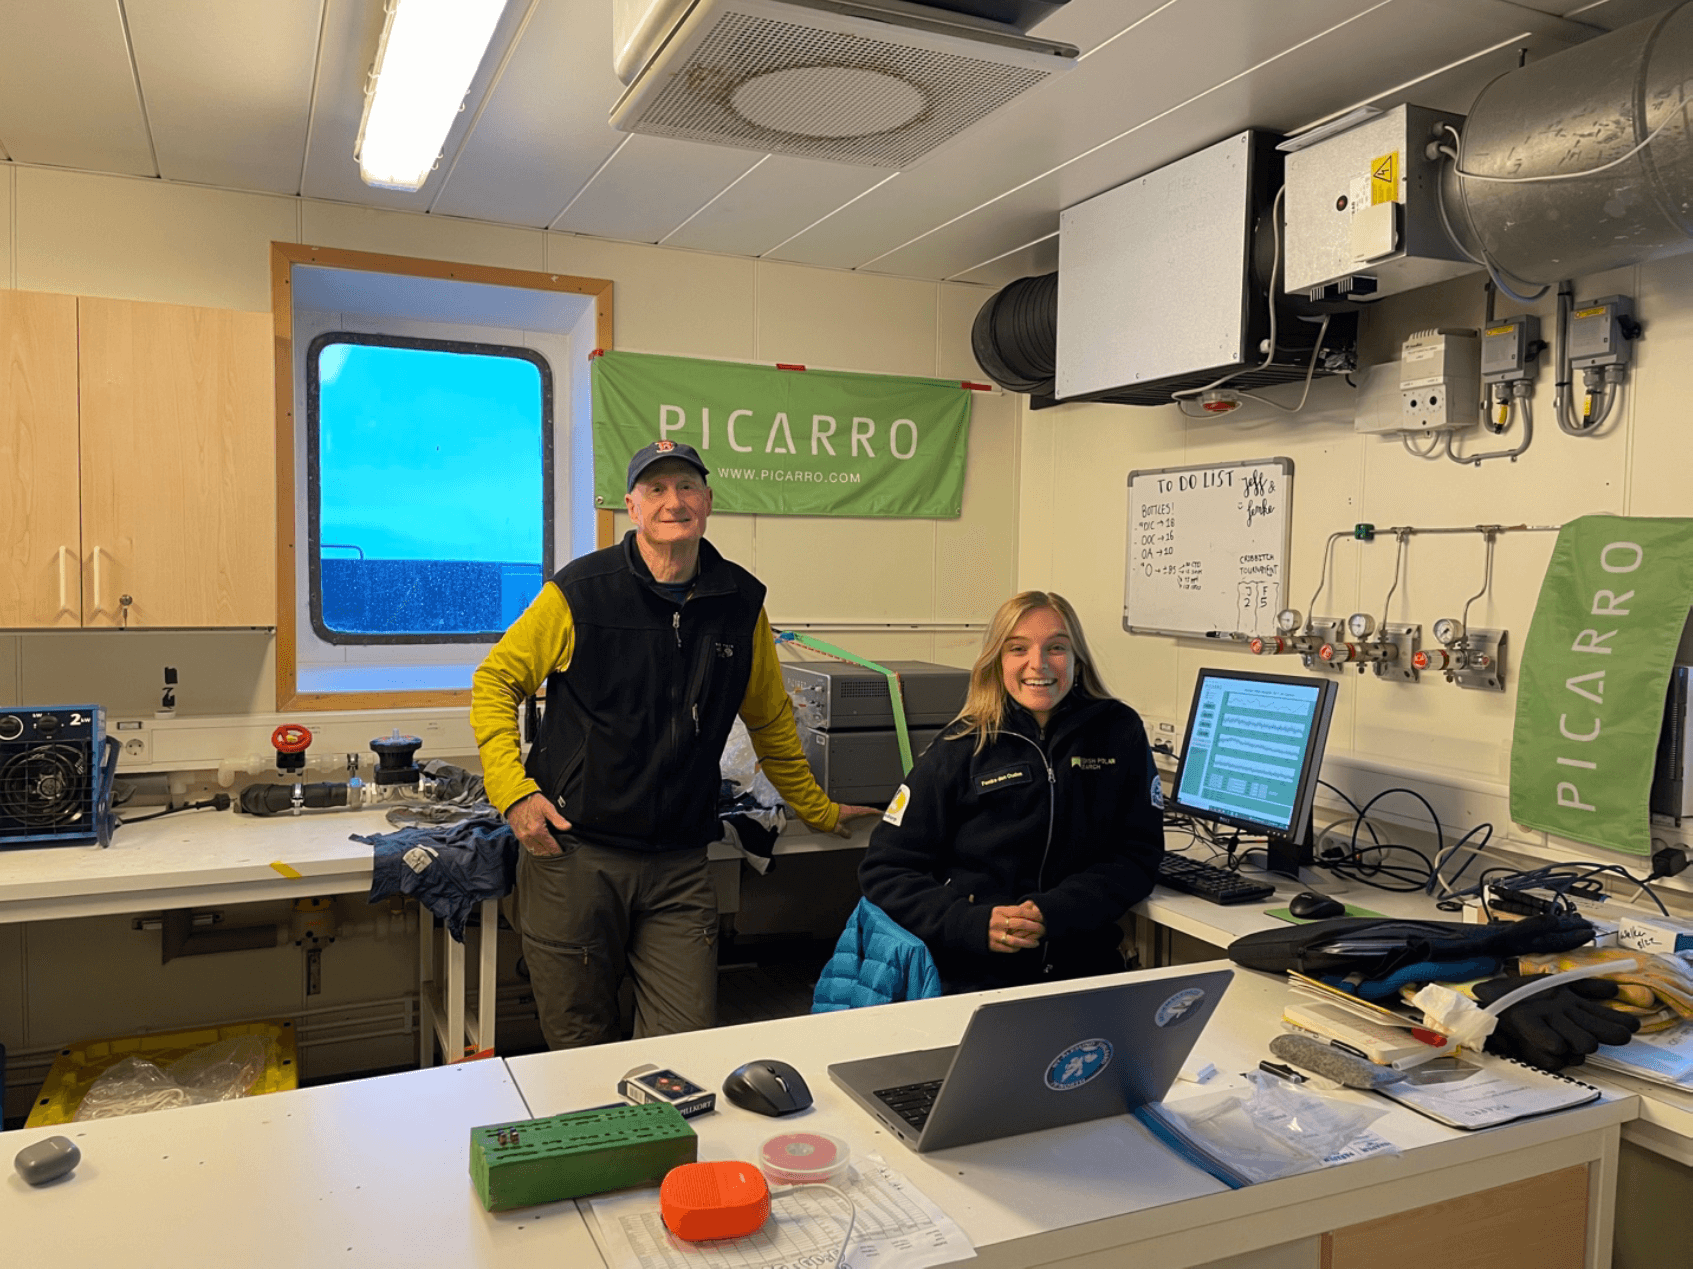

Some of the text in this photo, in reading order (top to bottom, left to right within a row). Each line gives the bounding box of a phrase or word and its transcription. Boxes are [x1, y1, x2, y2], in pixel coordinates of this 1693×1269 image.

[659, 404, 918, 460] PICARRO
[717, 466, 861, 484] WWW.PICARRO.COM
[1157, 479, 1173, 494] TO
[1179, 474, 1197, 492] DO
[1244, 597, 1267, 608] 2 5
[1557, 541, 1643, 812] PICARRO
[680, 1101, 711, 1115] PILLKORT
